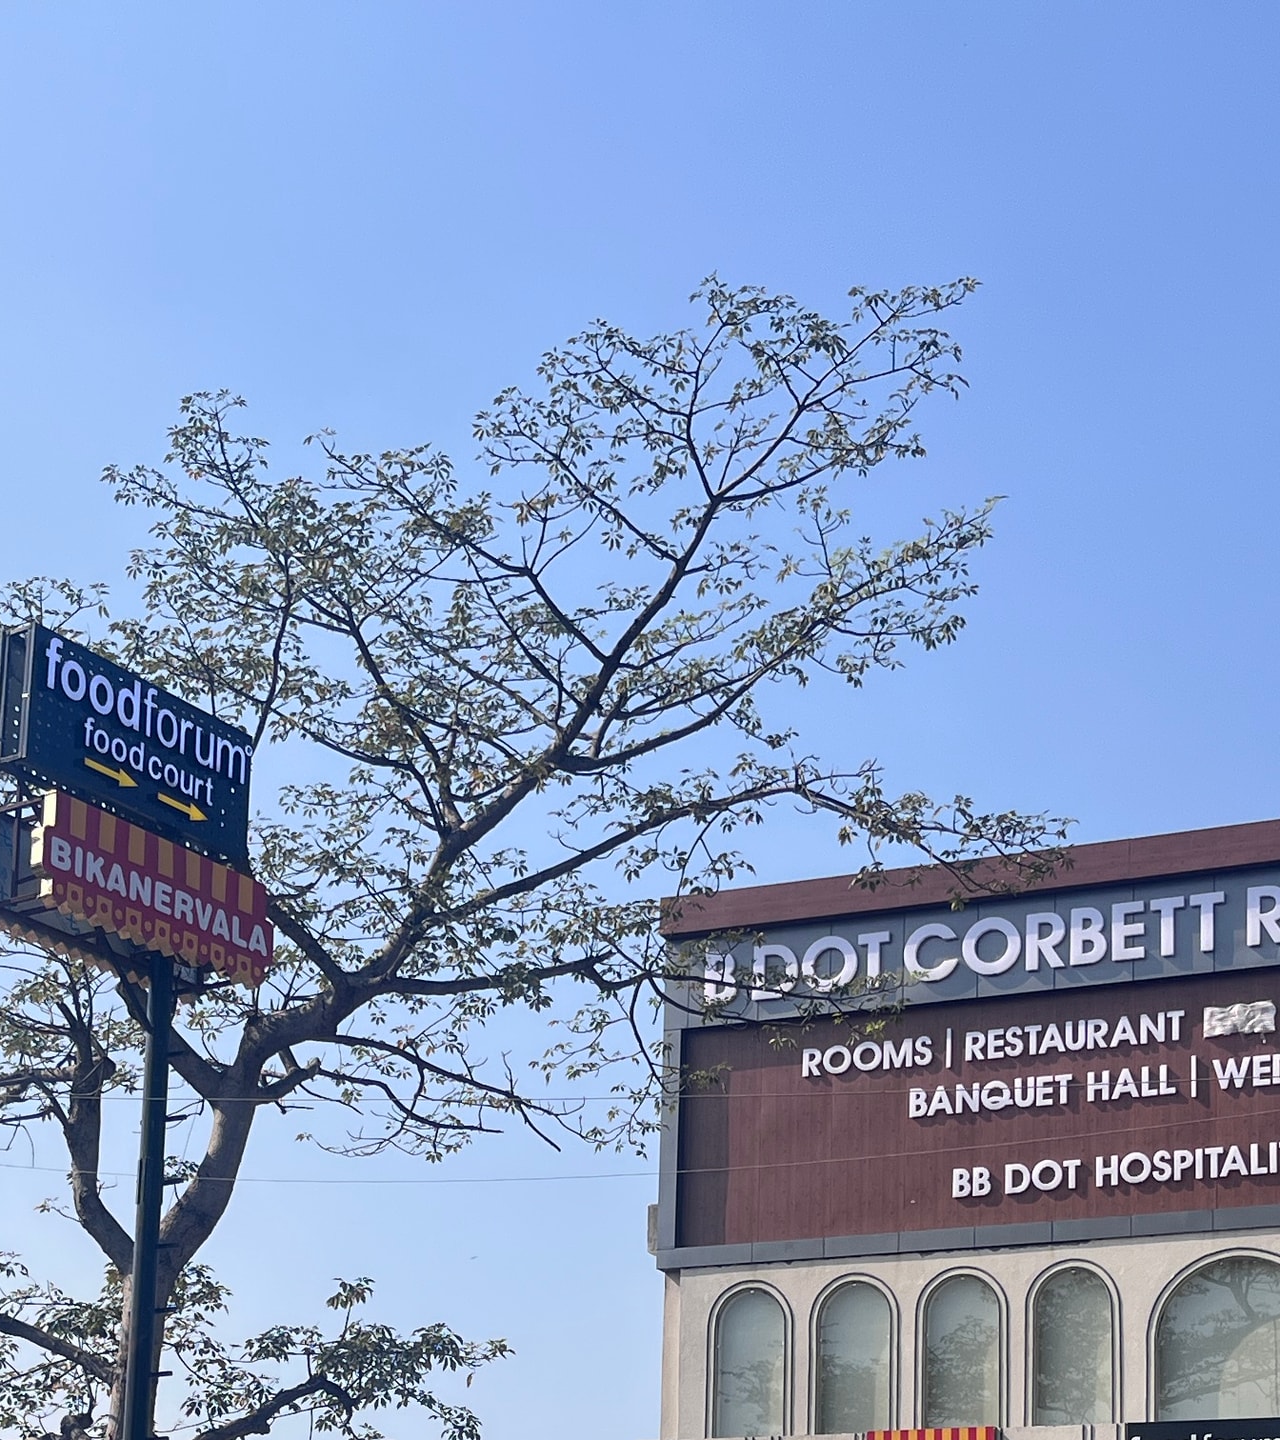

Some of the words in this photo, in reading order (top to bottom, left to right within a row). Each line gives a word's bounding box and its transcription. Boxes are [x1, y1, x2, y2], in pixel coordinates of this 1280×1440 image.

[51, 836, 269, 957] BIKANERVALA
[752, 930, 892, 1001] DOT
[904, 891, 1225, 982] CORBETT
[801, 1036, 933, 1078] ROOMS
[965, 1010, 1185, 1062] RESTAURANT
[908, 1074, 1073, 1119] BANQUET
[1087, 1064, 1176, 1102] HALL
[952, 1168, 991, 1199] BB
[1005, 1159, 1082, 1195] DOT
